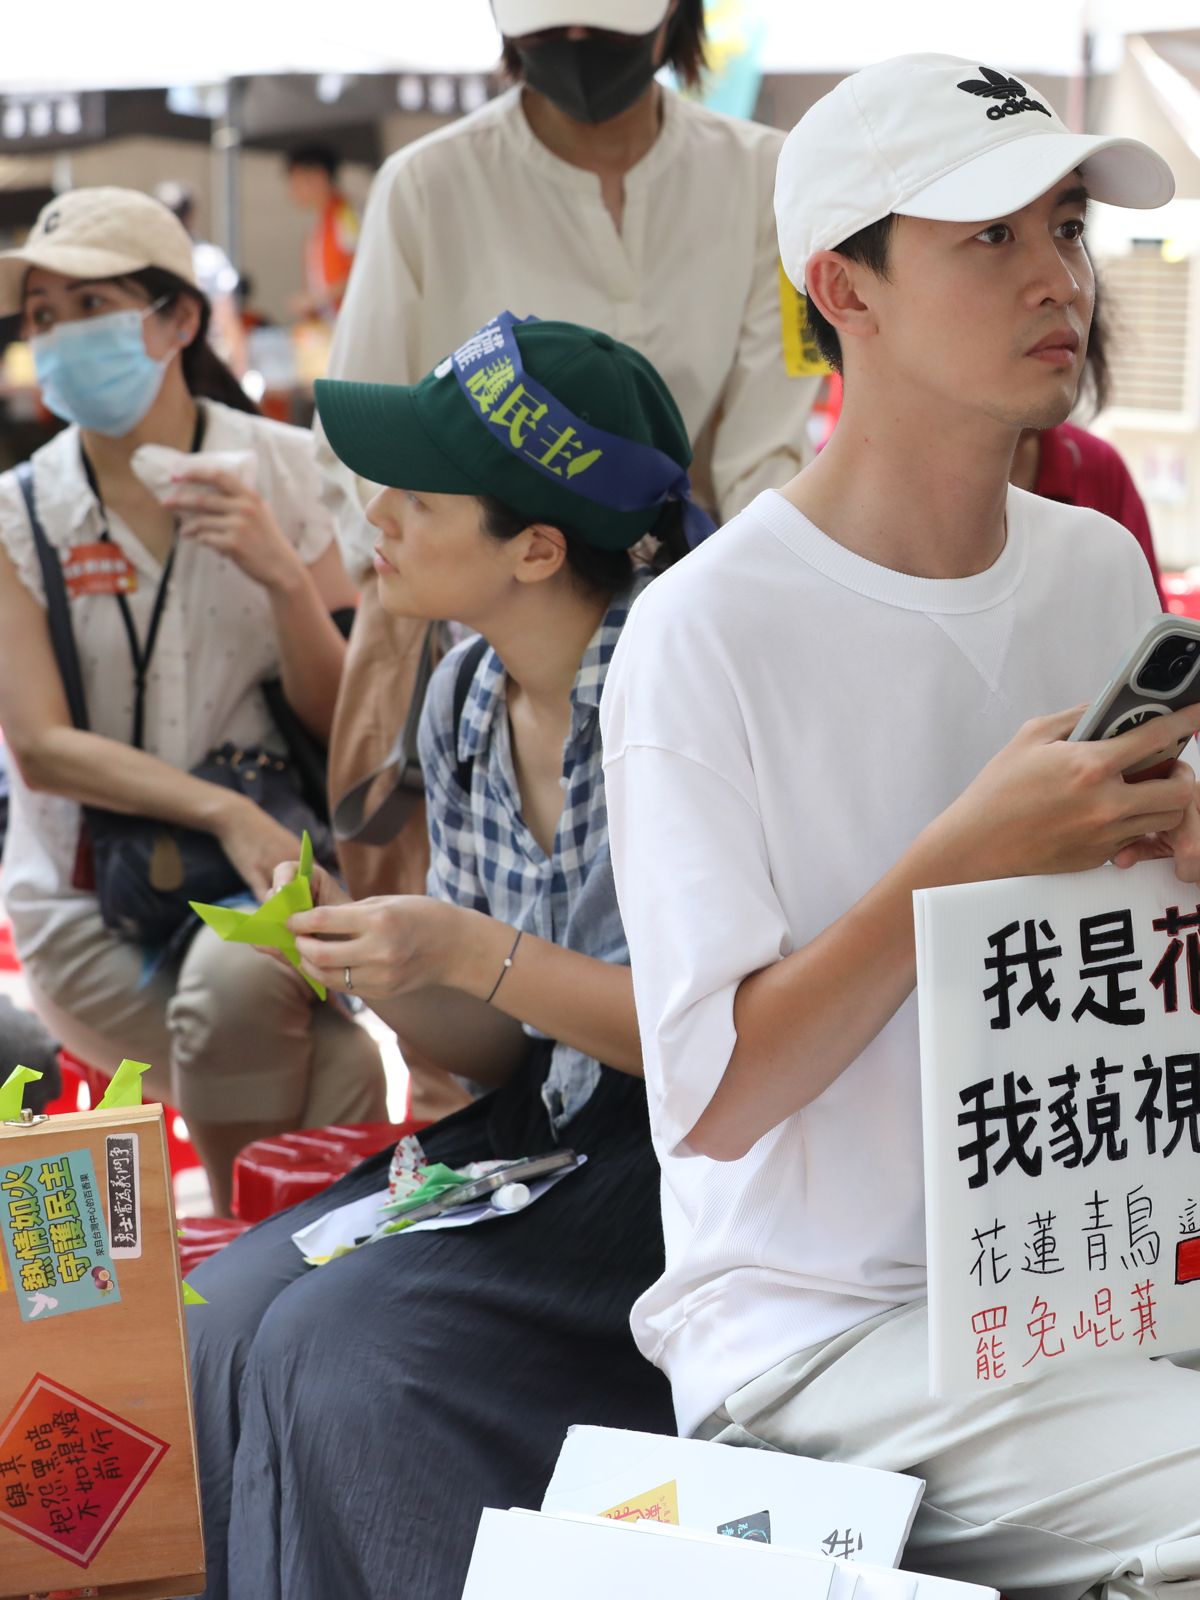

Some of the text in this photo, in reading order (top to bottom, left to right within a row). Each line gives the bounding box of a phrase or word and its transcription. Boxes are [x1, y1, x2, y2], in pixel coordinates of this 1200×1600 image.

[1, 1165, 57, 1292] 熱情如火
[38, 1157, 92, 1285] 守護民主
[969, 1184, 1160, 1287] 花蓮青鳥
[0, 1454, 34, 1508] 與其
[25, 1423, 77, 1535] 抱怨黑暗
[52, 1408, 101, 1521] 不如提燈
[90, 1427, 124, 1480] 前行
